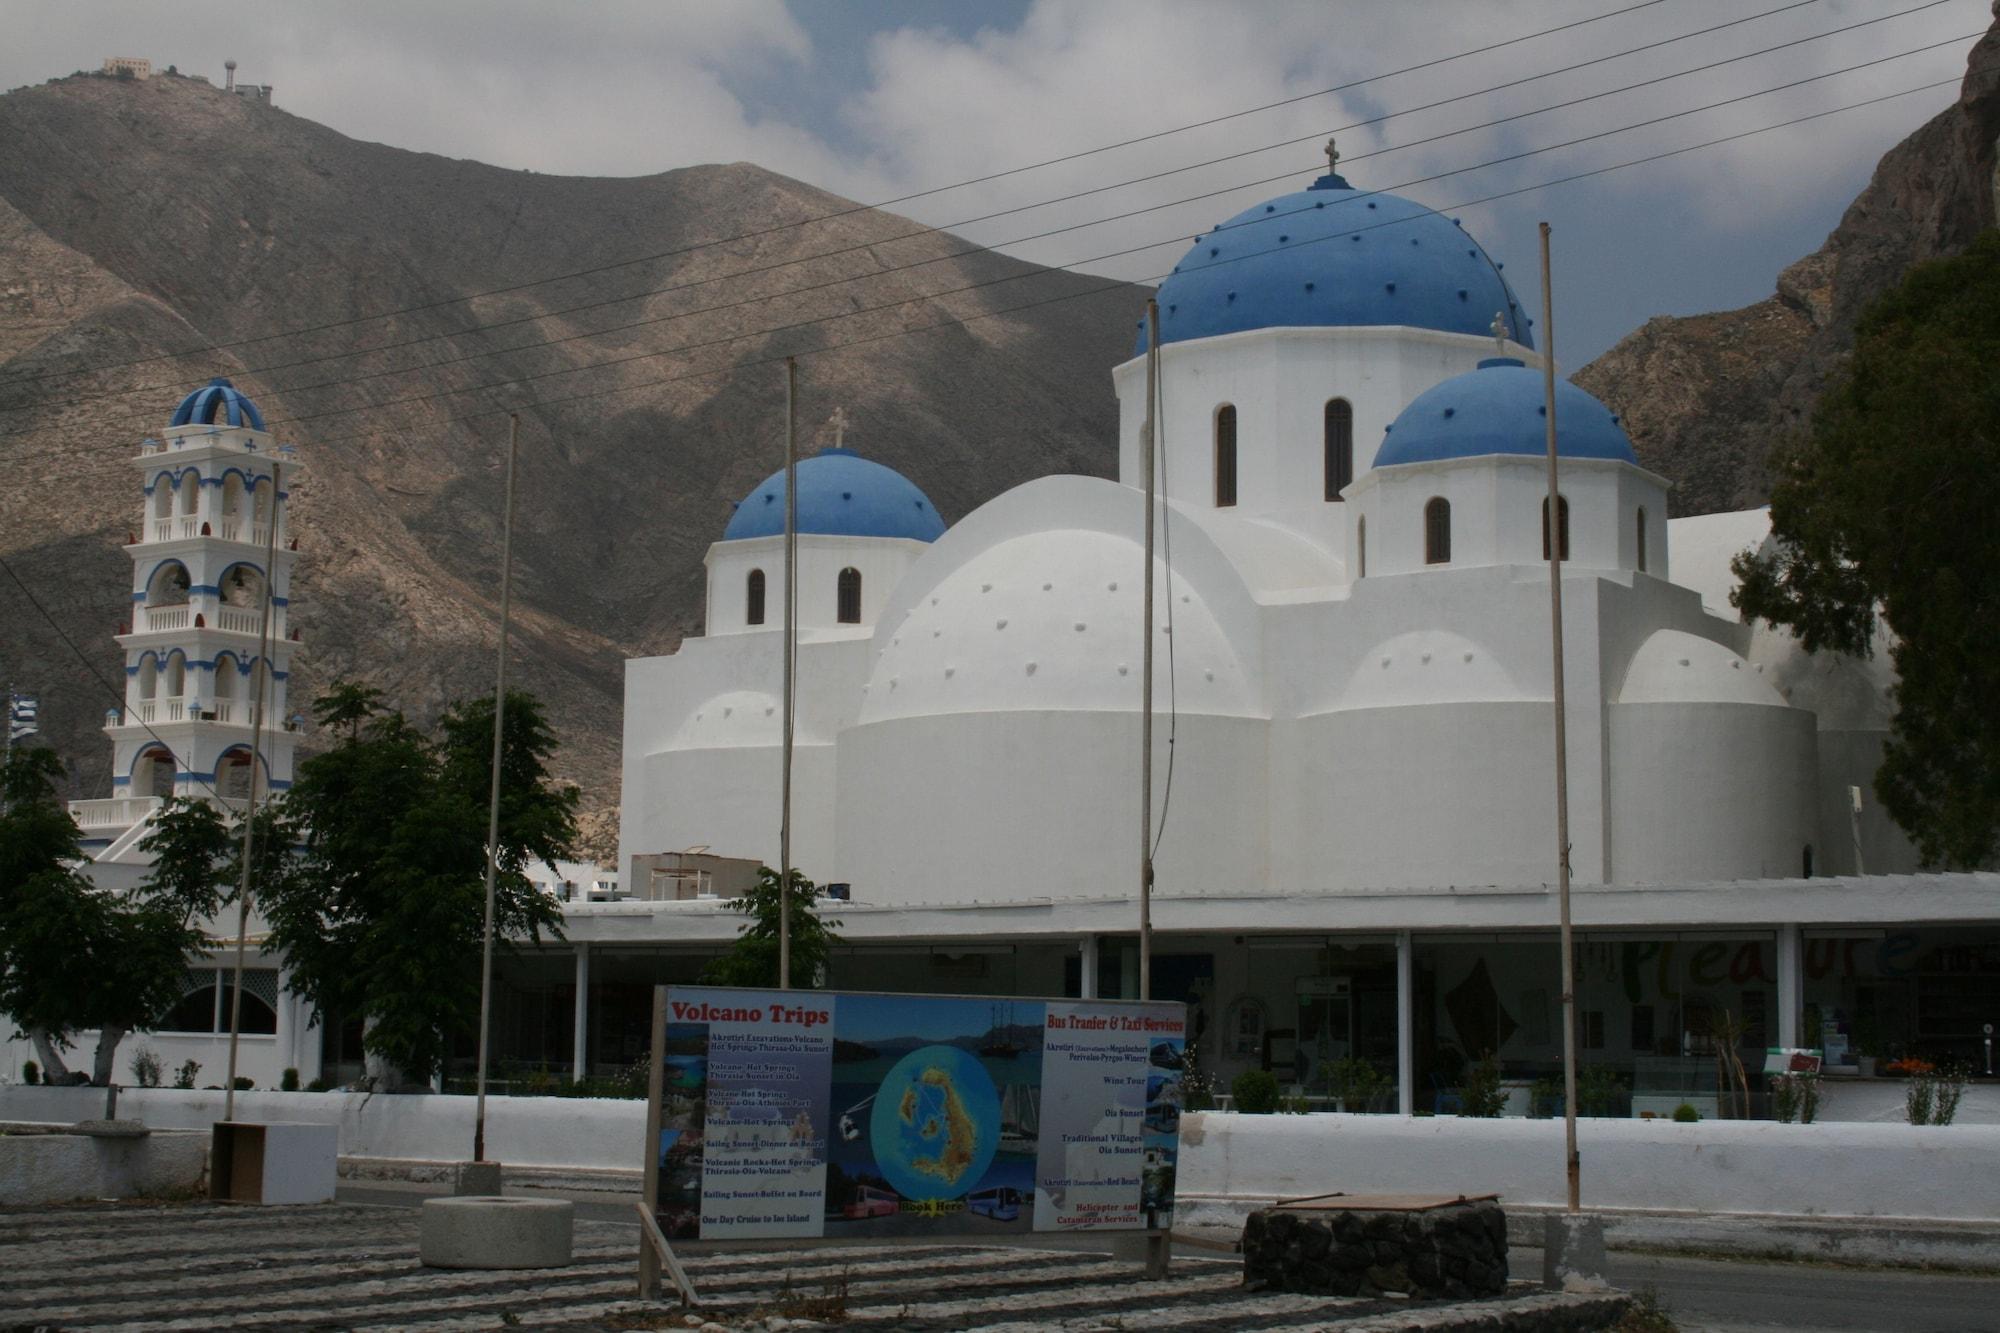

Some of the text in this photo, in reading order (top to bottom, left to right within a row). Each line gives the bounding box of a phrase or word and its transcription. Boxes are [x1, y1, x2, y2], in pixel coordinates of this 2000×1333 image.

[672, 1002, 829, 1027] Volcano Trips
[1047, 1014, 1184, 1032] Bus Tranfer & Taxi Services
[712, 1034, 744, 1042] Akrotiri
[711, 1042, 725, 1051] Hot
[804, 1045, 829, 1053] Sunset
[764, 1064, 795, 1073] Springs
[1104, 1076, 1146, 1085] Wine Tour
[757, 1091, 787, 1099] Springs
[1105, 1109, 1144, 1117] Oia Sunset
[762, 1118, 796, 1127] Springs
[1062, 1134, 1143, 1144] Traditional Villages
[1098, 1146, 1142, 1154] Oia Sunset
[1121, 1177, 1140, 1185] Beach
[703, 1190, 731, 1199] Sailing
[799, 1190, 822, 1198] Board
[902, 1201, 963, 1212] Book Here
[1076, 1203, 1138, 1213] Helicopter and
[702, 1216, 718, 1224] One
[719, 1215, 735, 1225] Day
[736, 1215, 762, 1224] Cruise
[786, 1214, 810, 1222] Island
[1057, 1216, 1138, 1225] Catamaran Services
